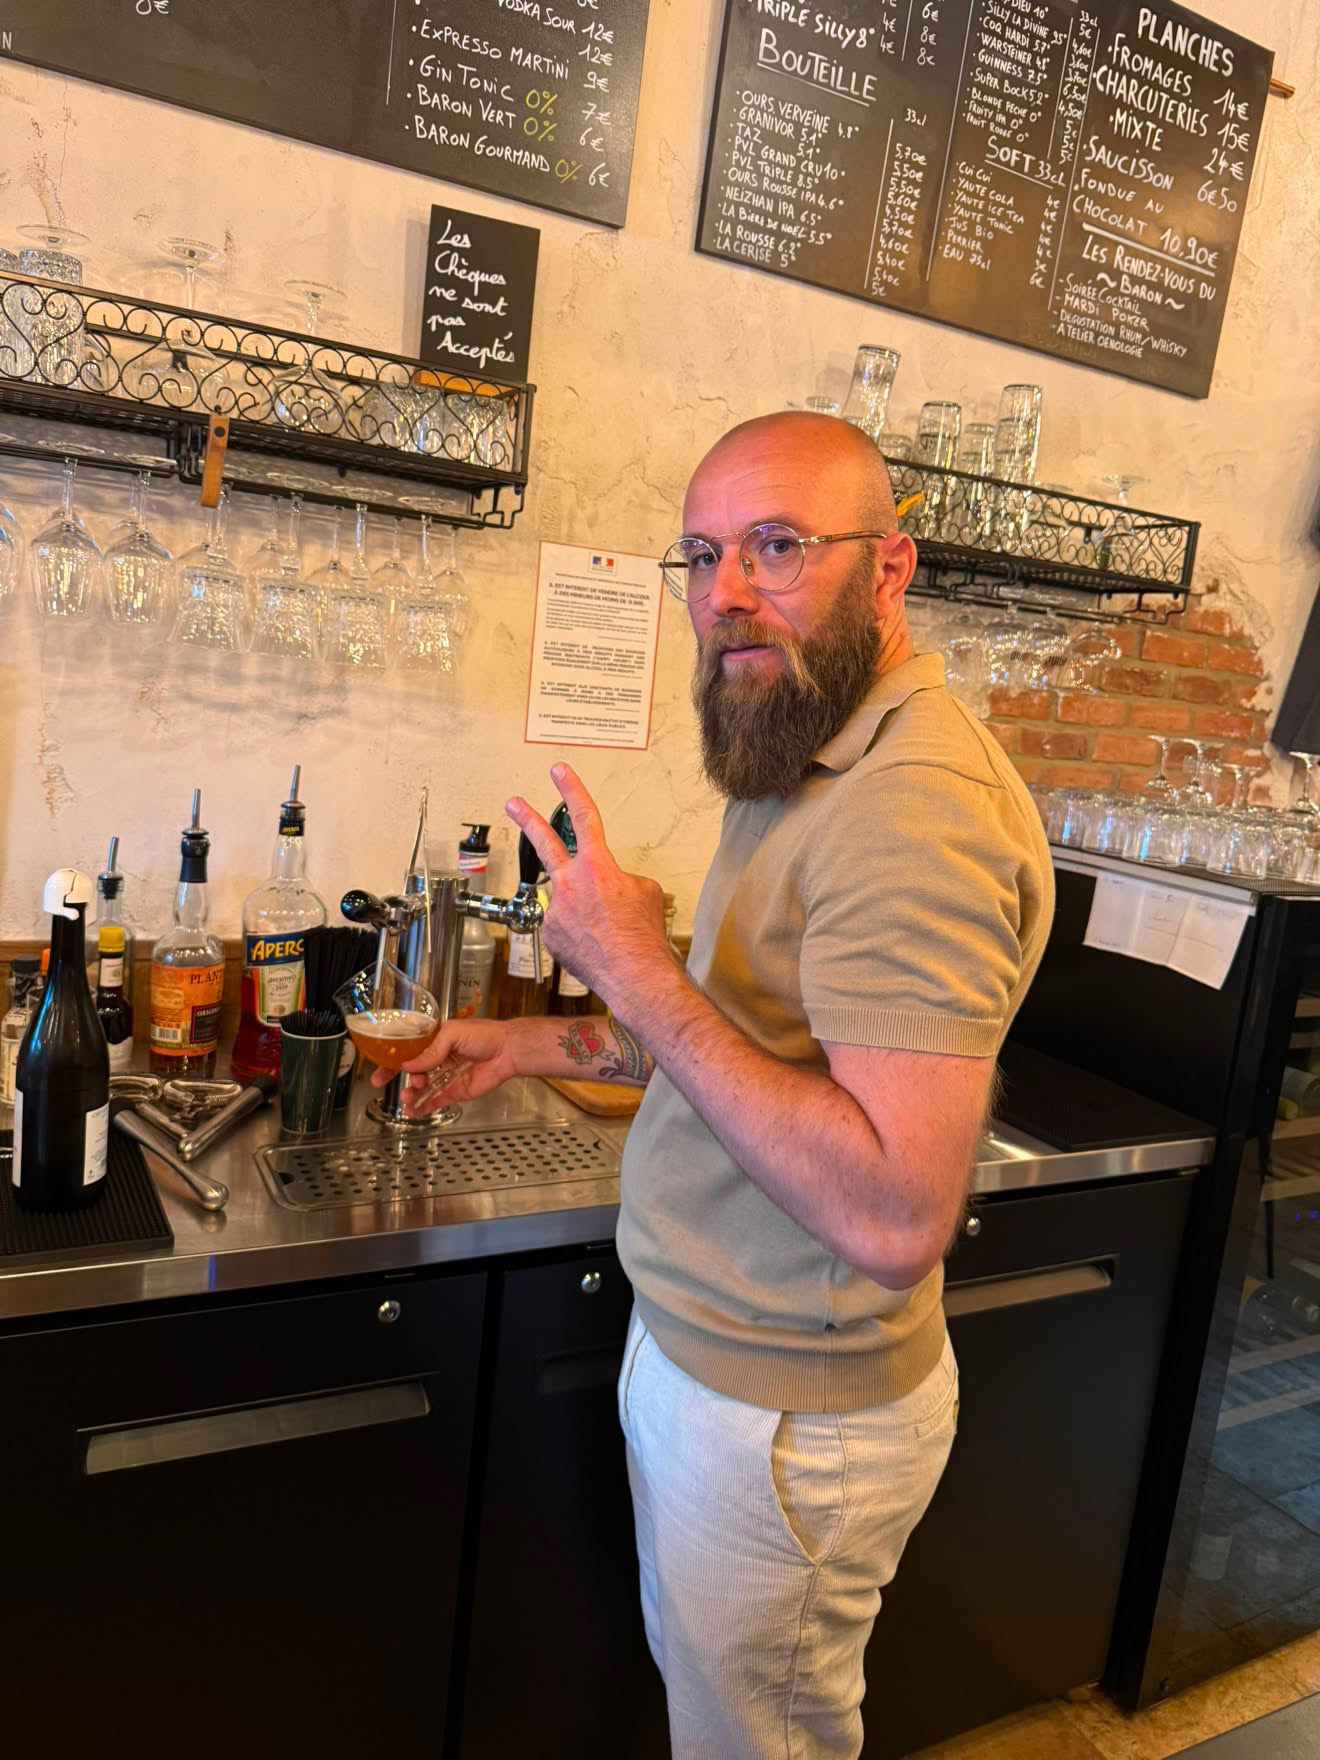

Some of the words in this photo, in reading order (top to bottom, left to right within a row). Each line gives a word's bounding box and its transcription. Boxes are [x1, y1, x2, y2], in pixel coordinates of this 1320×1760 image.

[543, 8, 576, 34] SOUR
[581, 21, 614, 44] 12€
[882, 11, 897, 32] 4€
[921, 2, 939, 21] 6€
[982, 16, 1002, 34] COQ
[1012, 13, 1021, 26] LA
[880, 34, 895, 54] 4€
[919, 25, 936, 45] 8€
[1078, 23, 1092, 39] 5€
[1137, 7, 1235, 78] PLANCHES
[420, 19, 502, 59] EXPRESSO
[584, 71, 609, 93] 9€
[578, 44, 613, 66] 12€
[758, 28, 878, 102] BOUTEILLE
[978, 49, 1023, 78] GUINNESS
[974, 67, 999, 90] SUPER
[1003, 79, 1028, 101] BOCK
[1112, 33, 1192, 96] FROMAGES
[1213, 88, 1249, 121] 14€
[526, 89, 558, 115] 0%
[582, 102, 611, 125] 7€
[971, 87, 1003, 109] BLONDE
[1095, 64, 1209, 137] CHARCUTERIES
[1217, 122, 1251, 152] 15€
[417, 84, 472, 118] BARON
[479, 99, 516, 129] VERT
[523, 117, 557, 141] 0%
[579, 127, 604, 151] 6€
[739, 106, 795, 140] GRANIVOR
[778, 100, 831, 134] VERVEINE
[737, 123, 762, 144] TAZ
[1113, 107, 1164, 151] MIXTE
[1203, 147, 1245, 181] 24€
[414, 115, 470, 149] BARON
[474, 136, 550, 172] GOURMAND
[555, 159, 583, 183] 0%
[588, 162, 612, 187] 6€
[760, 145, 797, 168] GRAND
[985, 135, 1036, 173] SOFT
[728, 166, 758, 187] OURS
[762, 175, 798, 198] ROUSSE
[800, 189, 816, 206] IPA
[1085, 135, 1175, 190] SAUCISSON
[1197, 179, 1238, 214] 6€50
[955, 189, 985, 209] YAUTE
[957, 176, 987, 197] YAUTE
[989, 190, 1015, 206] COLA
[1080, 168, 1137, 202] FONDUE
[1144, 198, 1164, 215] AU
[721, 202, 736, 218] LA
[952, 203, 983, 223] YAUTE
[436, 219, 472, 249] Les
[716, 235, 731, 252] LA
[718, 218, 732, 236] LA
[736, 224, 775, 249] ROUSSE
[1072, 194, 1149, 237] CHOCOLAT
[1159, 227, 1220, 269] 10,90€
[943, 244, 964, 261] EAU
[1081, 234, 1108, 264] LES
[1113, 244, 1195, 295] RENDEZ-VOUS
[1199, 282, 1216, 301] DU
[434, 250, 507, 297] Chèques
[428, 286, 458, 301] ne
[461, 296, 509, 316] sont
[426, 314, 466, 332] pas
[1111, 309, 1150, 332] POKER
[436, 331, 516, 369] Acceptés
